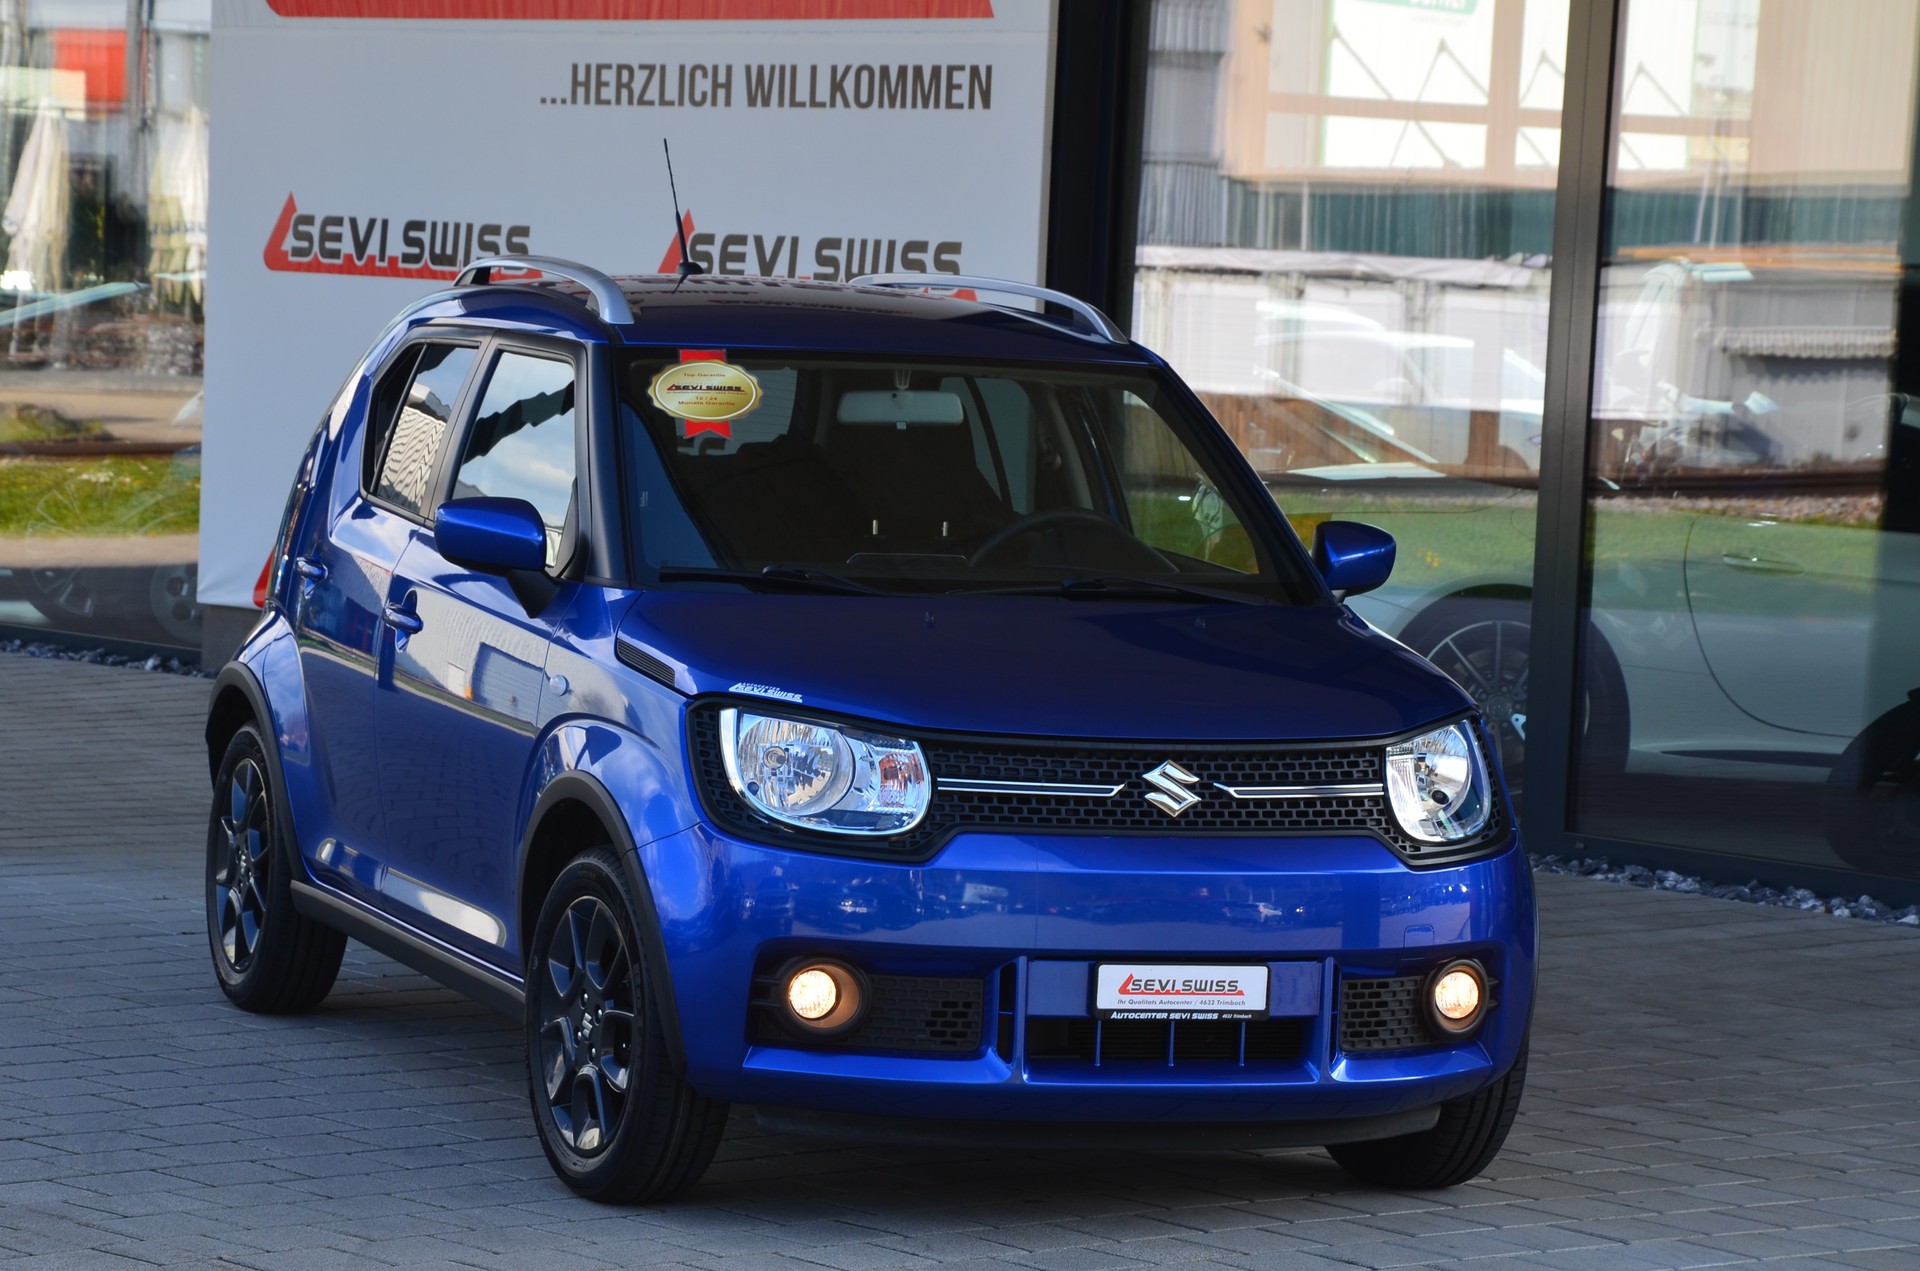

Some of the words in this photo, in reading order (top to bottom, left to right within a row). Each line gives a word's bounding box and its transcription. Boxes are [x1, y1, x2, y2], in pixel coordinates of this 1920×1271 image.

[744, 64, 992, 110] WILLKOMMEN
[290, 214, 389, 263] SEVI
[401, 220, 531, 267] SWISS
[689, 232, 800, 276] SEVI
[813, 237, 962, 281] SWISS
[1131, 979, 1176, 992] SEVI
[1182, 979, 1239, 993] SWISS
[1168, 1012, 1190, 1020] SEVI
[1192, 1012, 1219, 1020] SWISS
